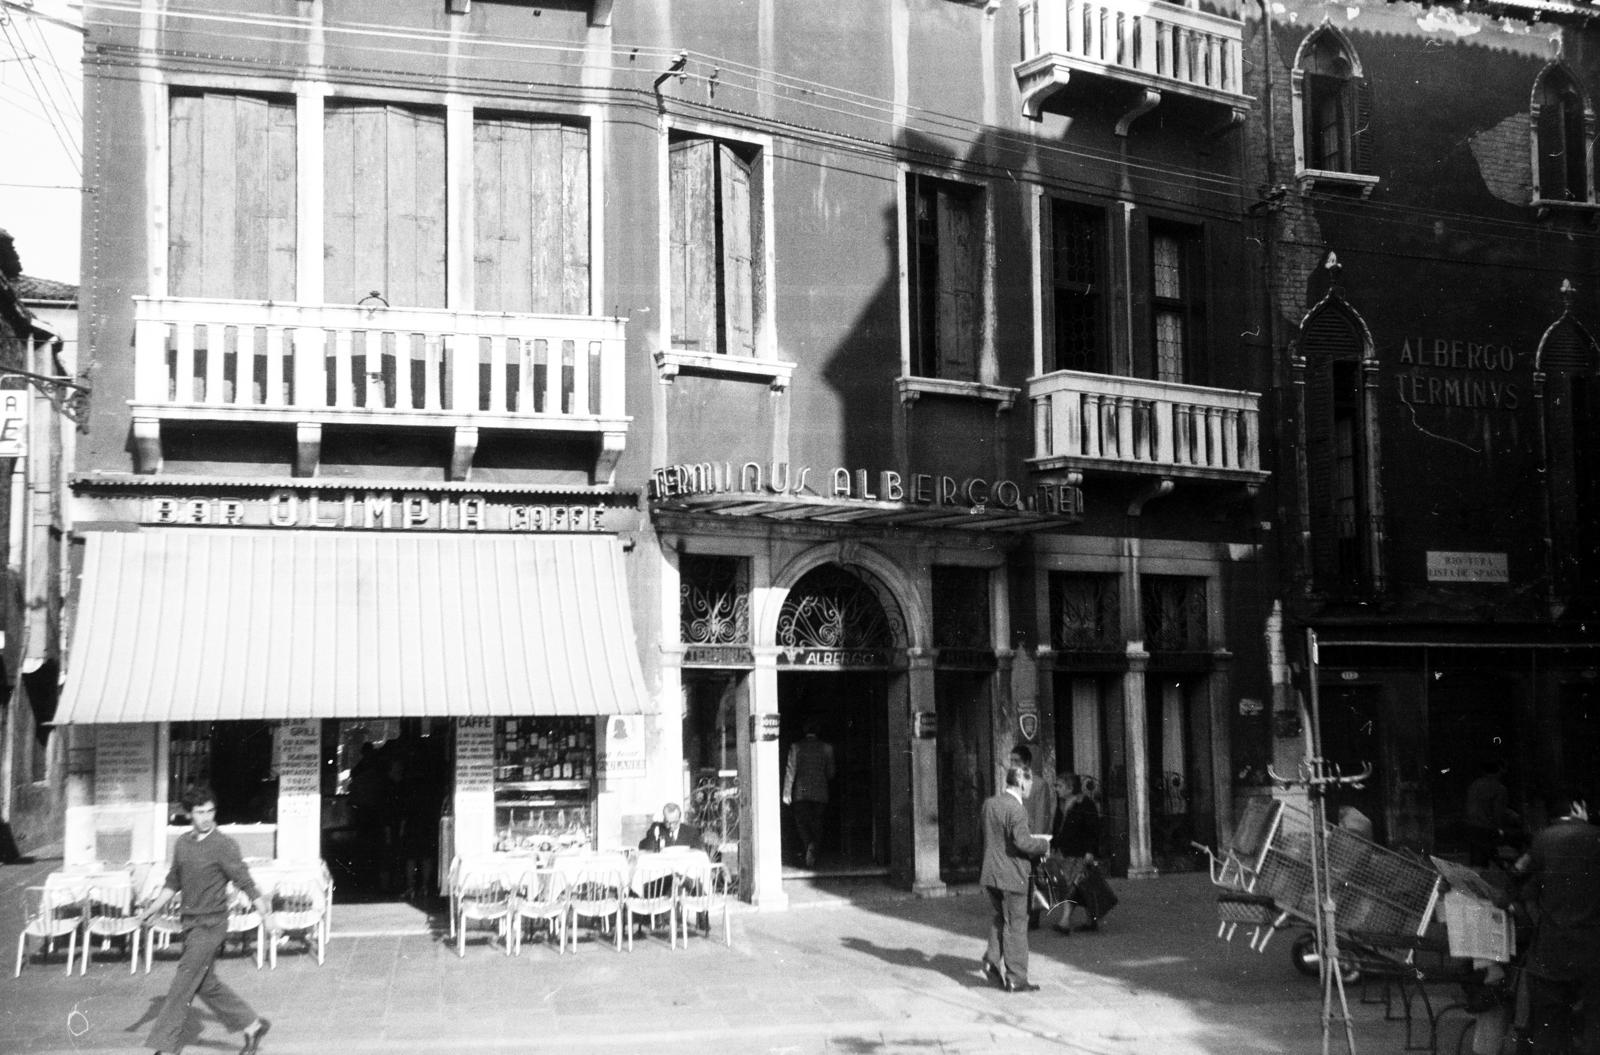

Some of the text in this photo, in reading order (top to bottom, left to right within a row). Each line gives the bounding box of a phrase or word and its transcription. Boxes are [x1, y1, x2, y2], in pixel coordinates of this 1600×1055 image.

[1399, 336, 1514, 371] ALBERGO
[833, 467, 1021, 507] ALBERGO
[152, 497, 247, 526] BAR
[270, 490, 486, 529] OLIMPIA
[805, 651, 874, 665] ALBERGO
